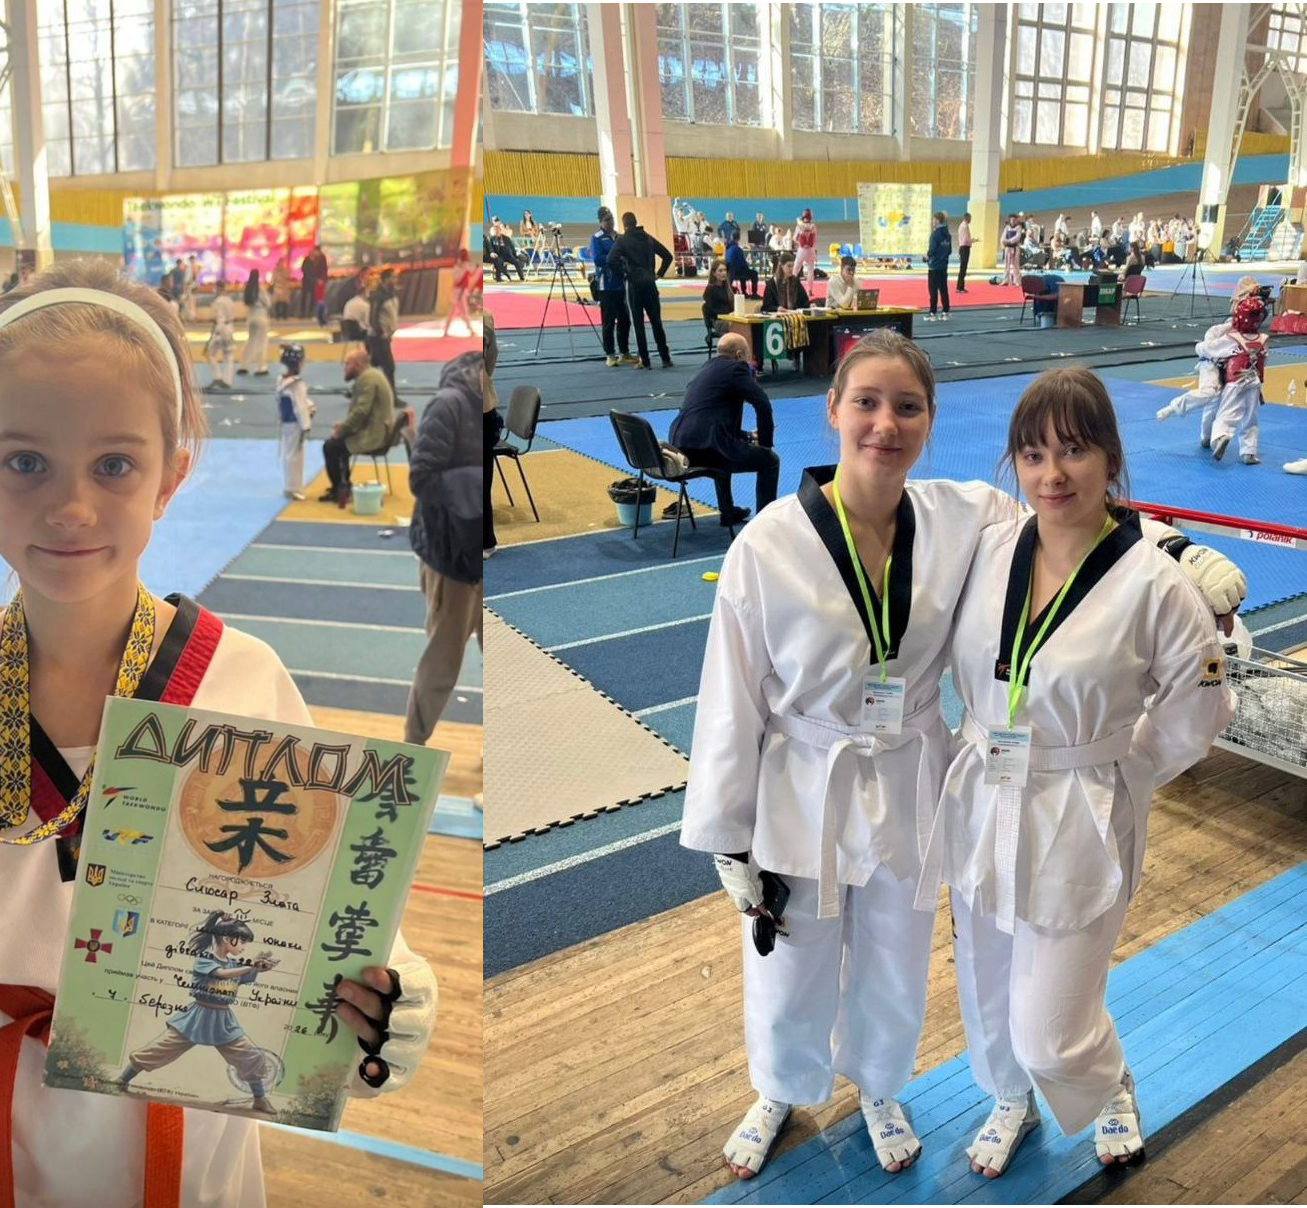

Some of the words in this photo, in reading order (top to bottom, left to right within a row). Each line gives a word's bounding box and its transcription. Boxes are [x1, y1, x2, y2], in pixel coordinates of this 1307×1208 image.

[765, 322, 784, 356] 6
[114, 711, 412, 806] ДИПЛОМ
[122, 801, 167, 812] TAEKWONDO
[186, 876, 239, 906] Слюсар
[260, 889, 300, 912] Злата
[252, 917, 274, 928] МІСЦЕ
